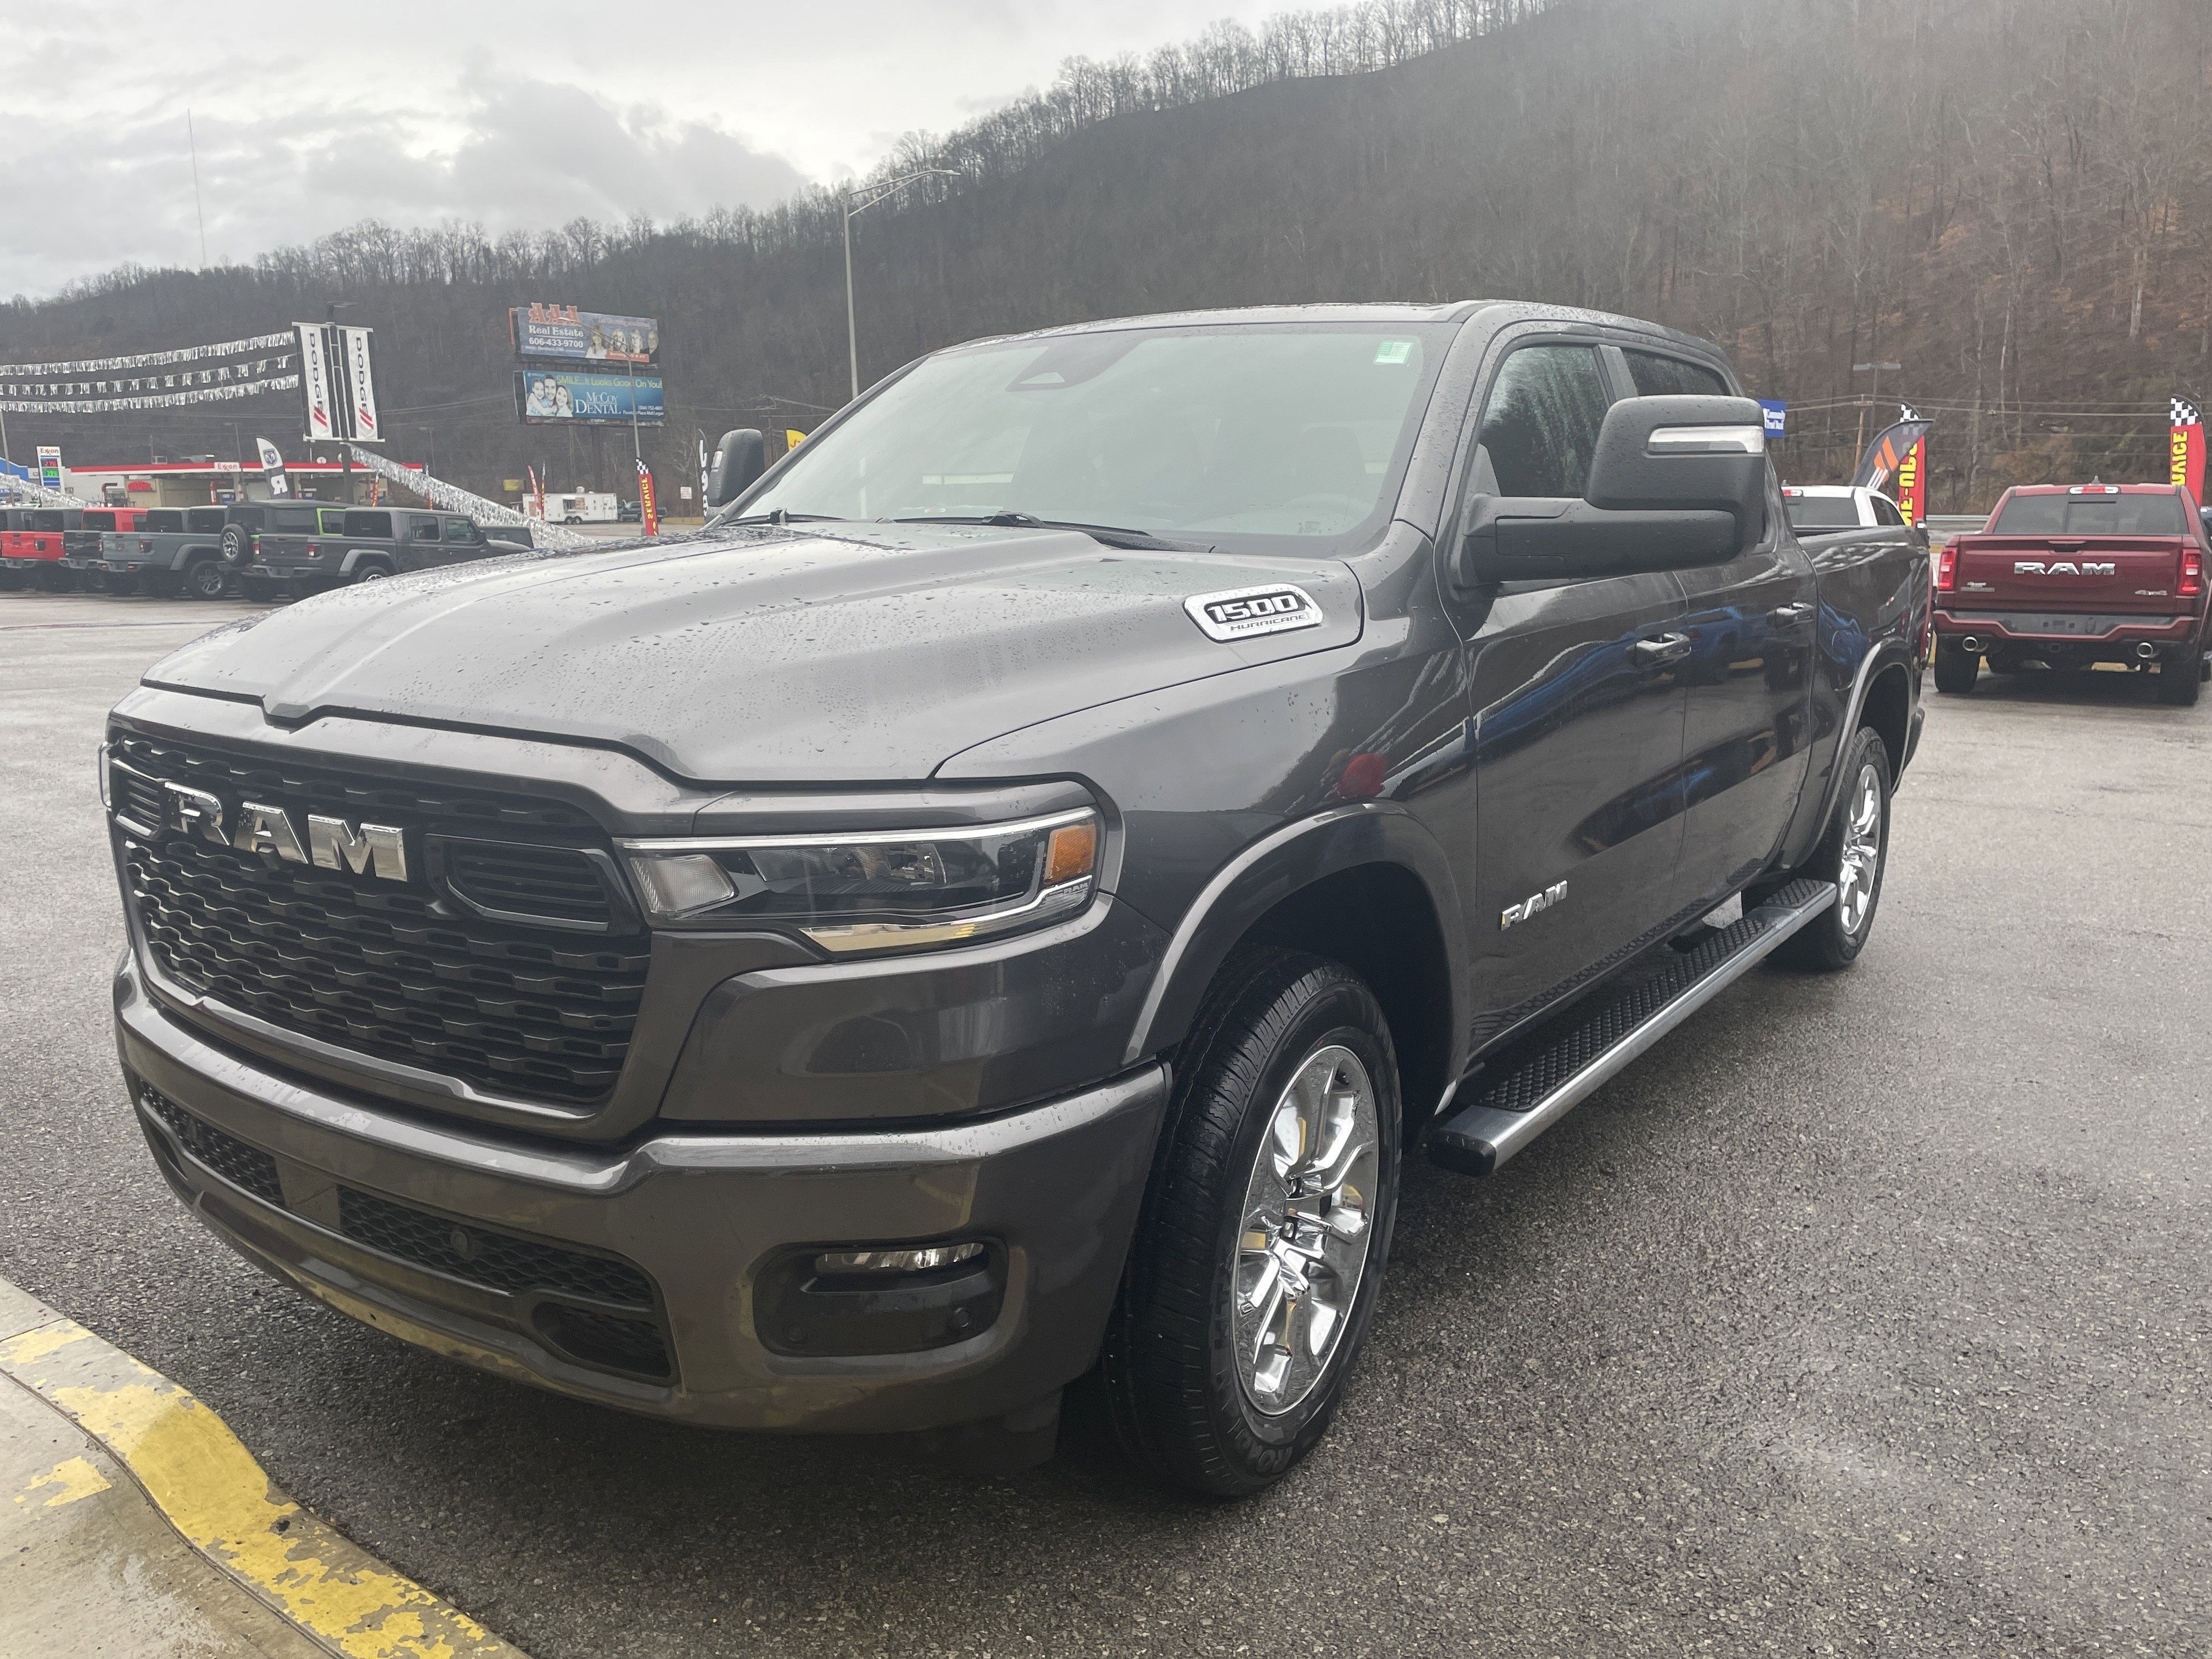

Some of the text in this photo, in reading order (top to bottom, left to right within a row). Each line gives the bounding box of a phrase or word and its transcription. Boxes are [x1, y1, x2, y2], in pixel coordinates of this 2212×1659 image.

[528, 325, 584, 337] Real Estate
[528, 337, 584, 348] 606-433-9700
[309, 333, 323, 415] DODGE
[356, 337, 368, 416] DODGE
[591, 377, 612, 386] Looks
[635, 379, 647, 388] On
[647, 380, 663, 388] You!
[2014, 562, 2115, 575] RAM
[1206, 594, 1299, 622] 1500
[1230, 614, 1306, 631] HURRICANE
[165, 781, 408, 883] RAM
[1063, 882, 1088, 895] RAM
[1500, 879, 1568, 932] RAM
